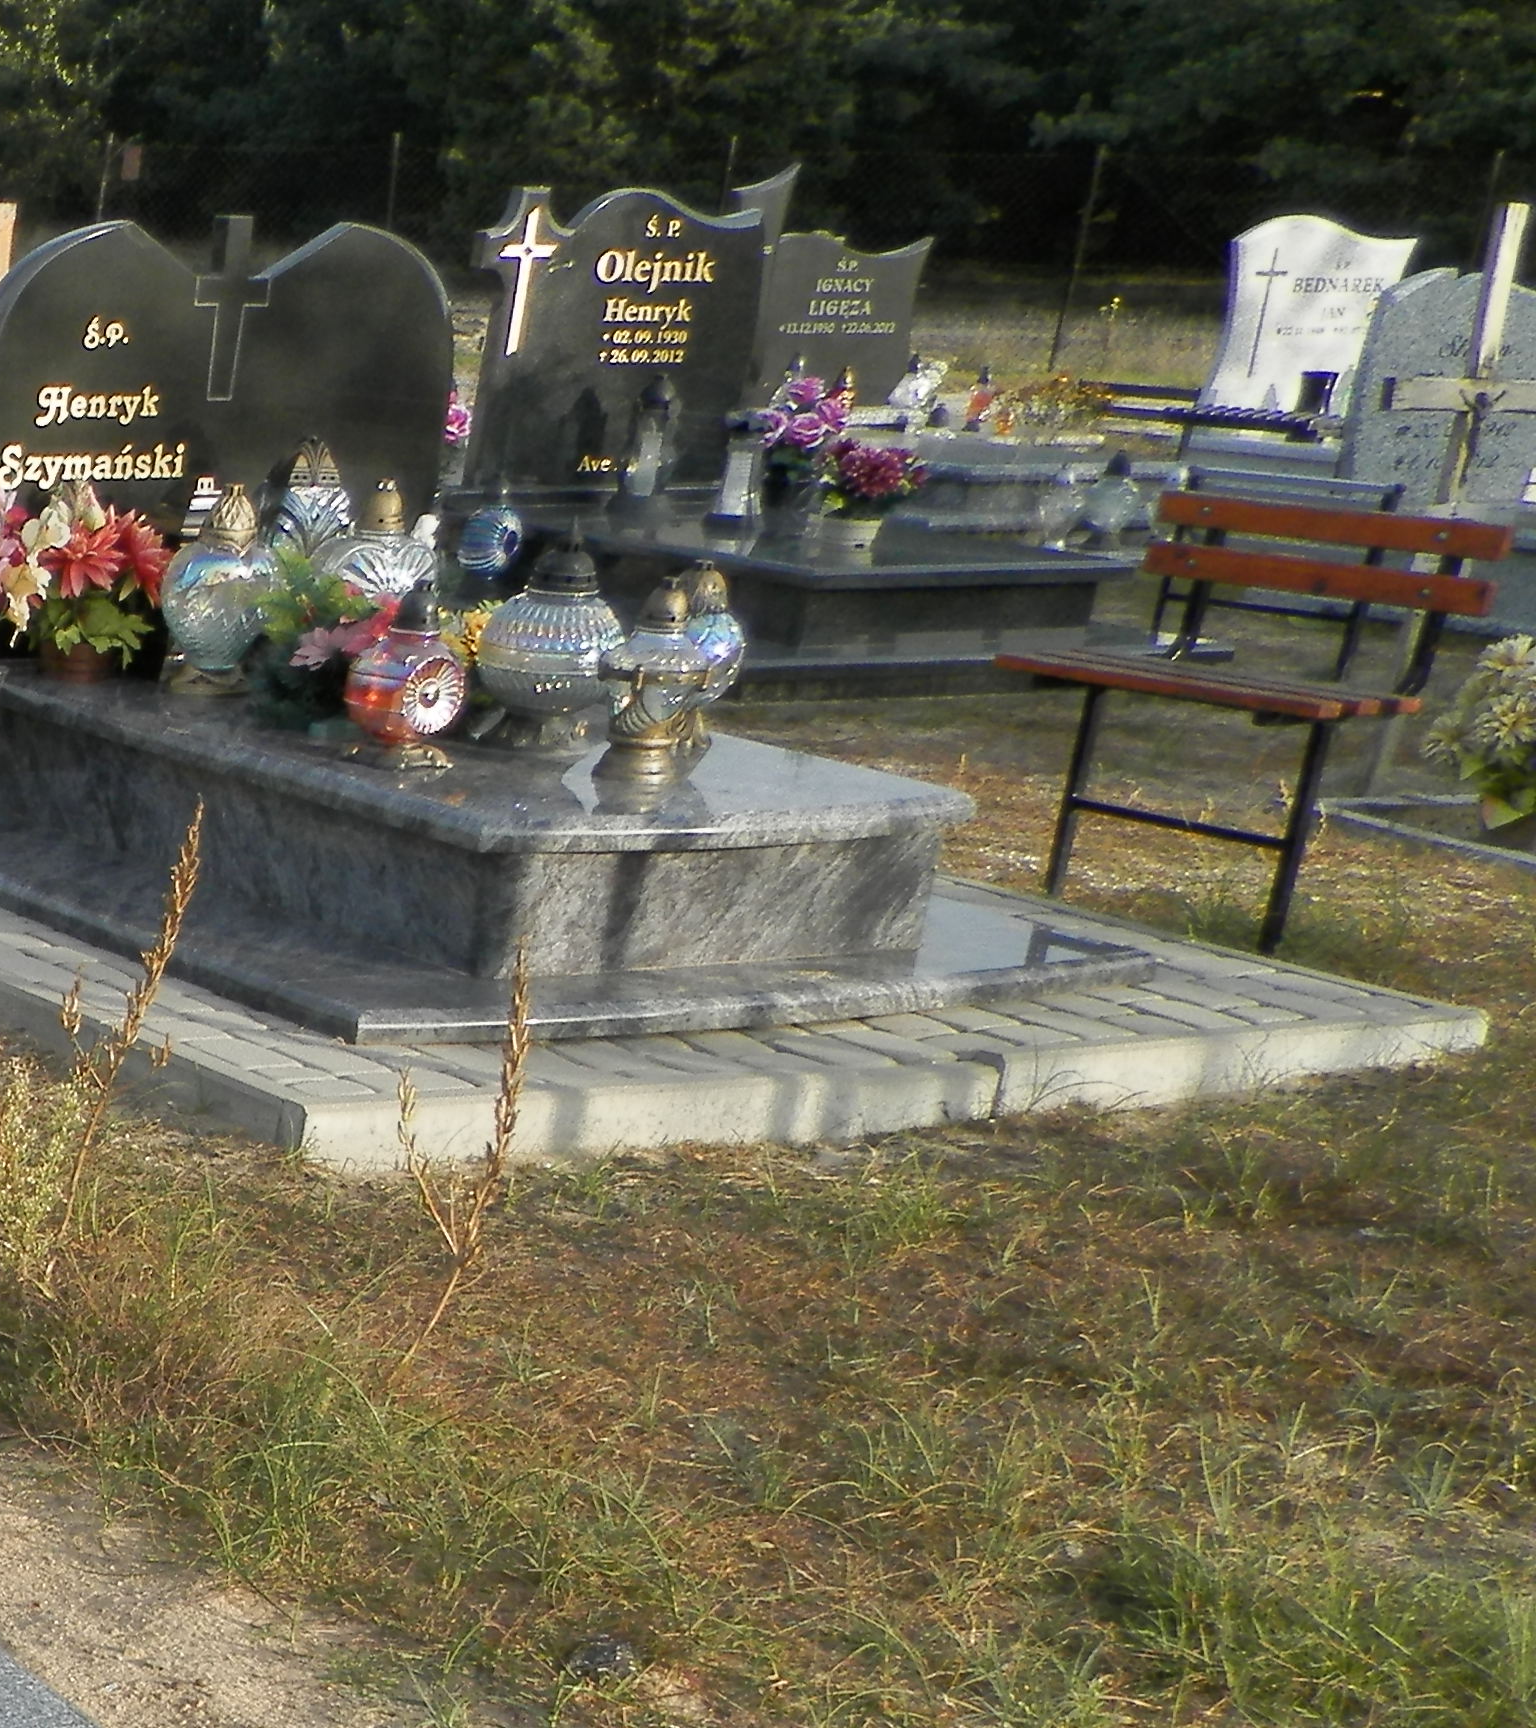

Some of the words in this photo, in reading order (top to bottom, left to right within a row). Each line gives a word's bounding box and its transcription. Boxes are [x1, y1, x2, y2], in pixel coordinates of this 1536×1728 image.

[595, 250, 716, 293] Olejnik
[816, 278, 875, 293] IGNACY
[1292, 276, 1384, 293] BEDNAREK
[602, 298, 692, 330] Henryk
[34, 385, 160, 428] Henryk
